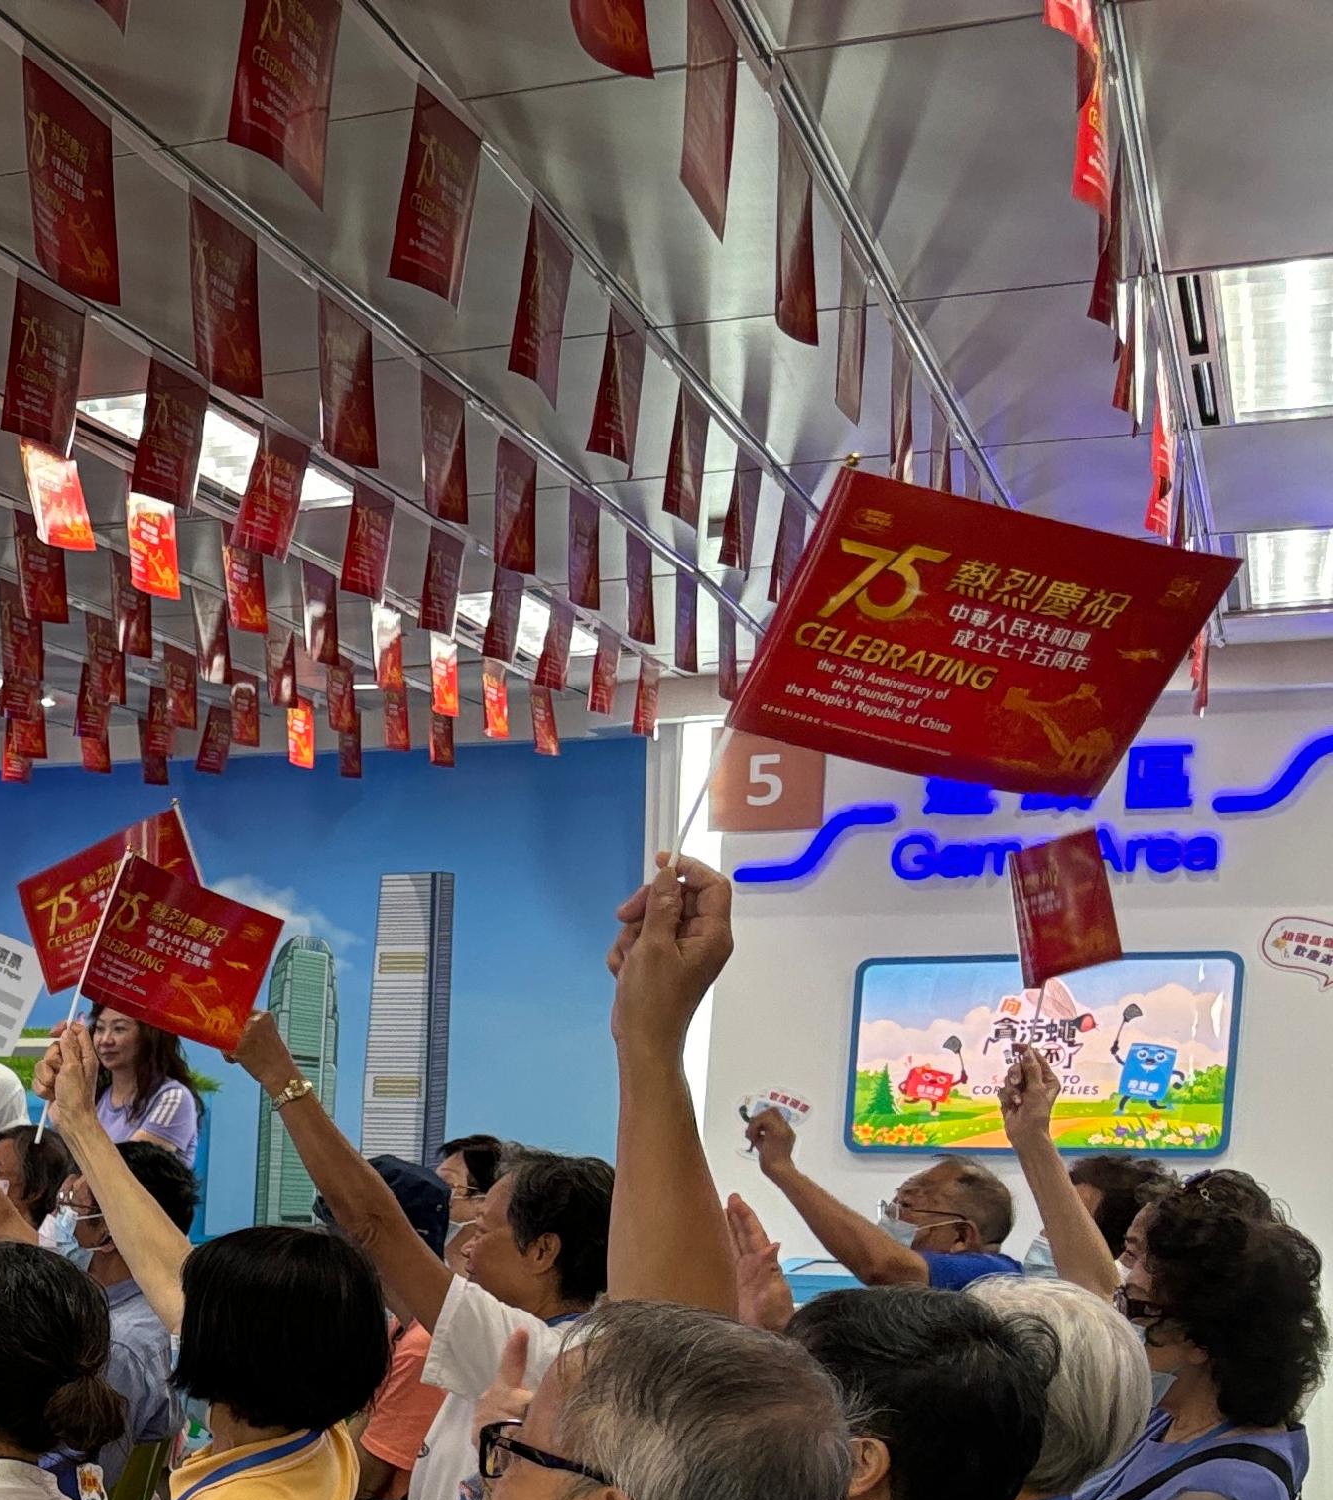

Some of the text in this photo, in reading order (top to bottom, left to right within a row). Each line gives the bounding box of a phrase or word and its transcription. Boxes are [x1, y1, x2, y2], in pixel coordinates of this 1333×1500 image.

[817, 538, 952, 621] 75
[946, 558, 1134, 631] 熱烈慶祝
[948, 603, 1092, 652] 中華人民共和國
[795, 622, 999, 691] CELEBRATING
[951, 628, 1091, 674] 成立七十五周年
[817, 659, 949, 700] the 75th Anniversary of
[832, 678, 921, 710] the Founding of
[785, 683, 952, 734] the People's Republic of China
[745, 754, 784, 806] 5
[891, 833, 1022, 880] Gam
[36, 882, 79, 937] 75
[108, 890, 150, 933] 75
[146, 902, 229, 947] 熱烈慶祝
[146, 925, 213, 958] 中華人民共和國
[146, 937, 214, 970] 成立七十五周年
[1001, 998, 1021, 1016] 向
[1062, 1085, 1099, 1095] FLIES
